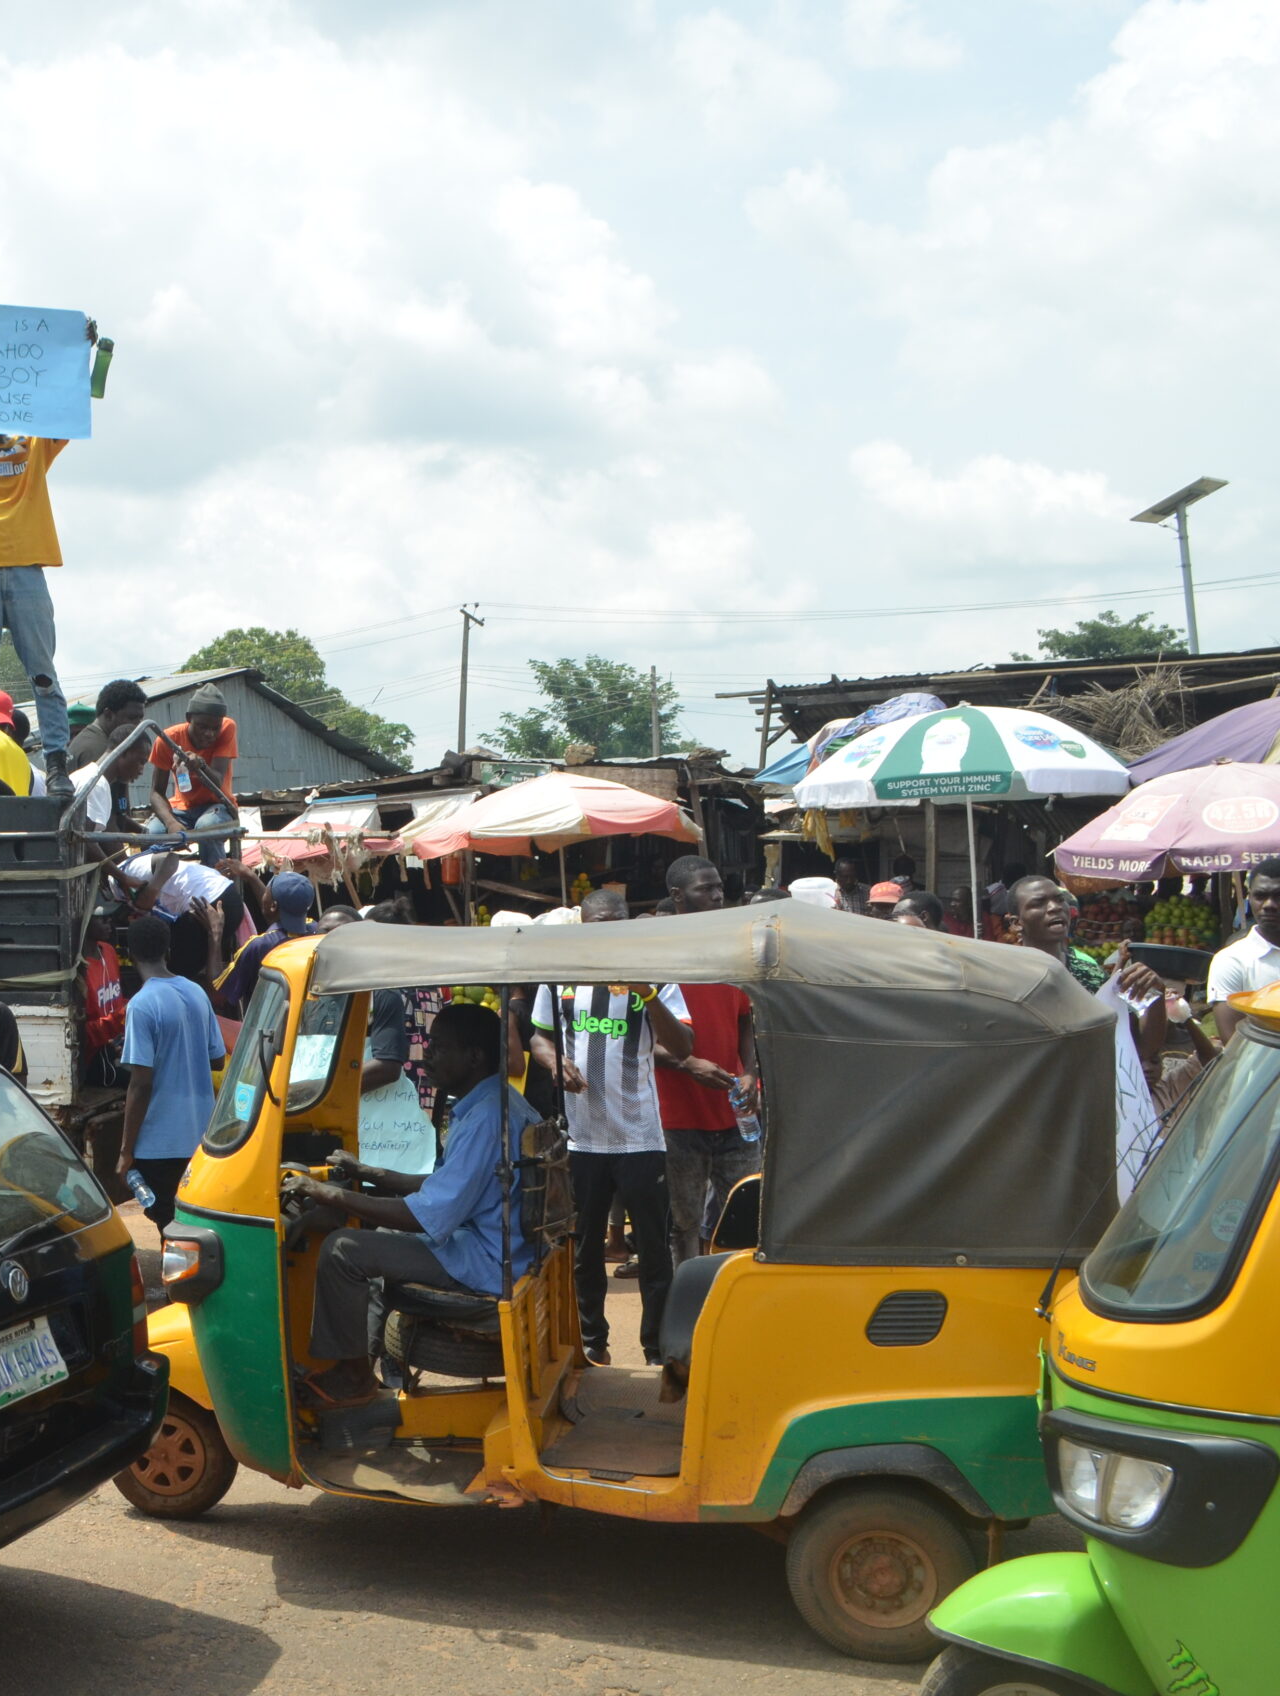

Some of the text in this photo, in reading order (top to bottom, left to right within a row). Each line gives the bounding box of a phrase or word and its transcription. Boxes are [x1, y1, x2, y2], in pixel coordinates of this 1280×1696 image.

[15, 319, 28, 333] IS
[37, 317, 50, 333] A
[887, 774, 1001, 790] SUPPORT YOUR IMMUNE
[901, 783, 991, 797] SYSTEM WITH ZINC
[1072, 855, 1152, 873] YIELDS MORE
[1180, 853, 1233, 867] RAPID
[572, 1009, 628, 1039] Jeep
